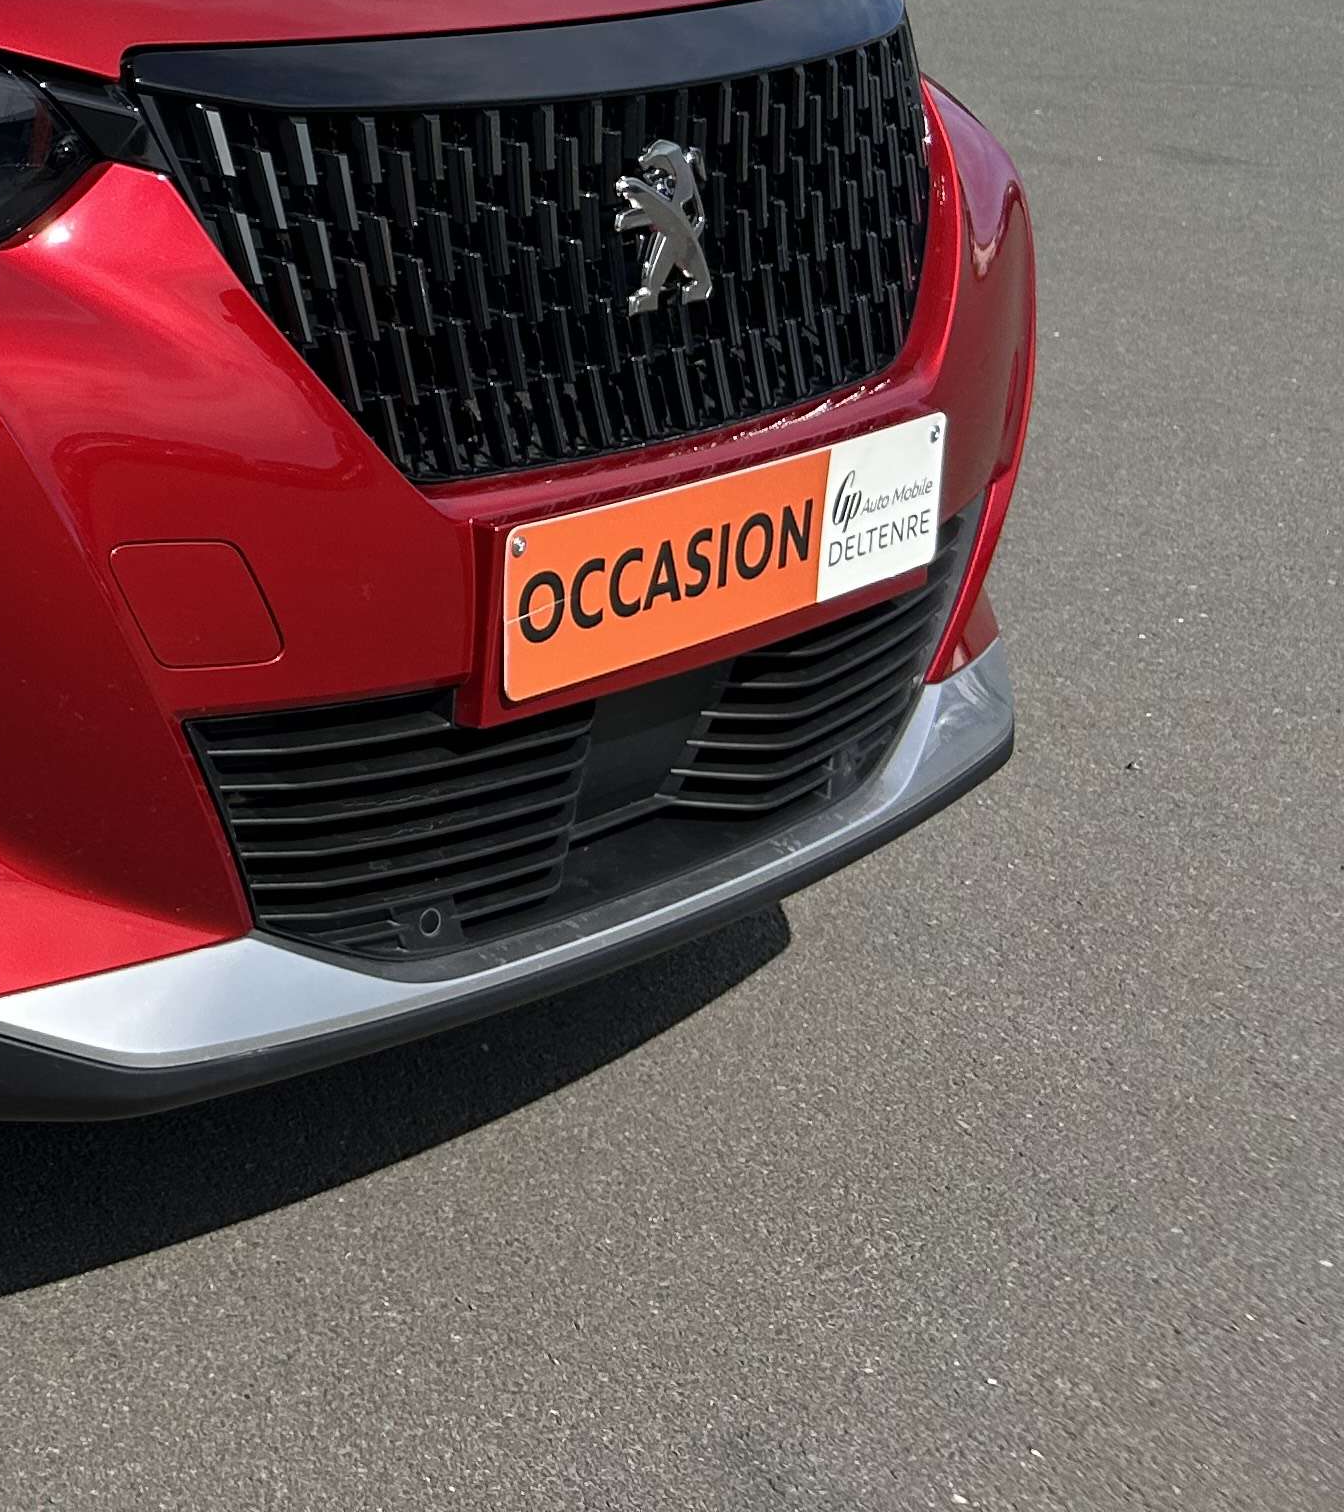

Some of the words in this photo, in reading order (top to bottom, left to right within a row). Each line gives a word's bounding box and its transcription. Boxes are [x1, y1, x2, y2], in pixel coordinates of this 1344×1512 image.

[860, 495, 890, 516] Auto
[891, 477, 934, 506] Mobile
[827, 508, 931, 567] DELTENRE
[518, 499, 813, 644] OCCASION
